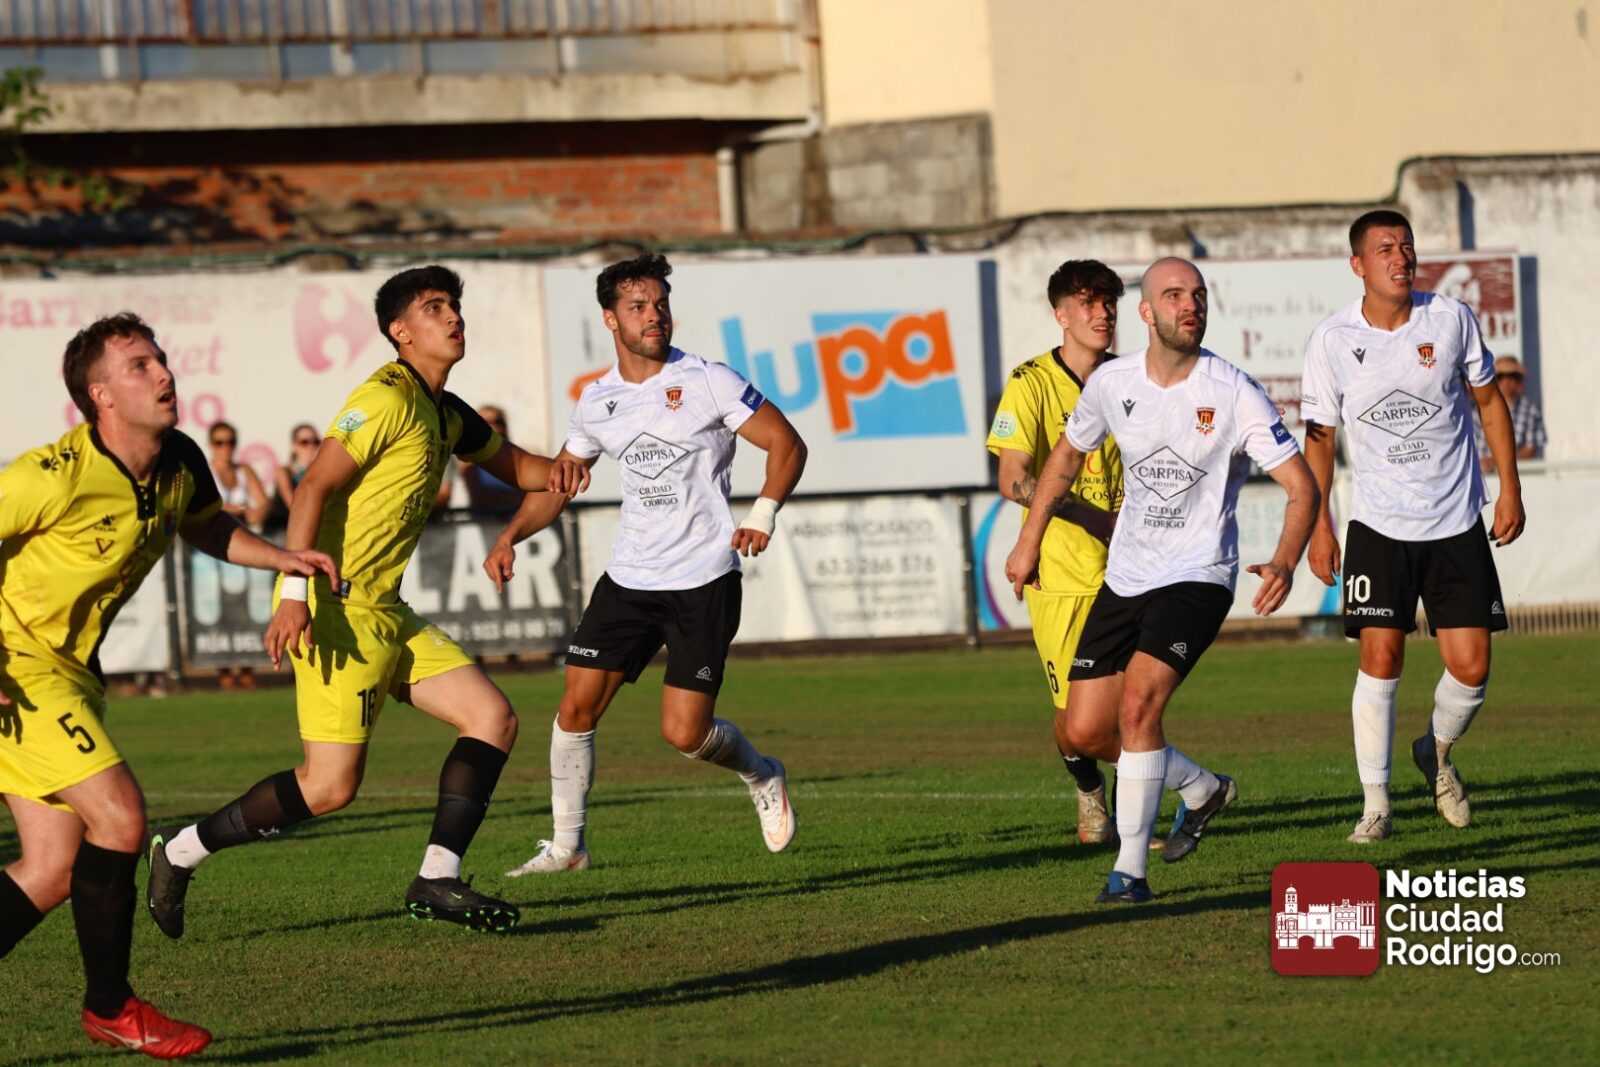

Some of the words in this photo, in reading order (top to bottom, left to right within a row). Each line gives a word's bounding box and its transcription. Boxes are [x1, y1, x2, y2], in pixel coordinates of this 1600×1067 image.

[720, 309, 957, 434] lupa
[1370, 405, 1431, 422] CARPISA
[625, 447, 677, 466] CARPISA
[1388, 441, 1425, 454] CIUDAD
[1137, 464, 1195, 483] CARPISA
[1345, 574, 1372, 604] 10
[1046, 659, 1060, 694] 6
[57, 712, 96, 754] 5
